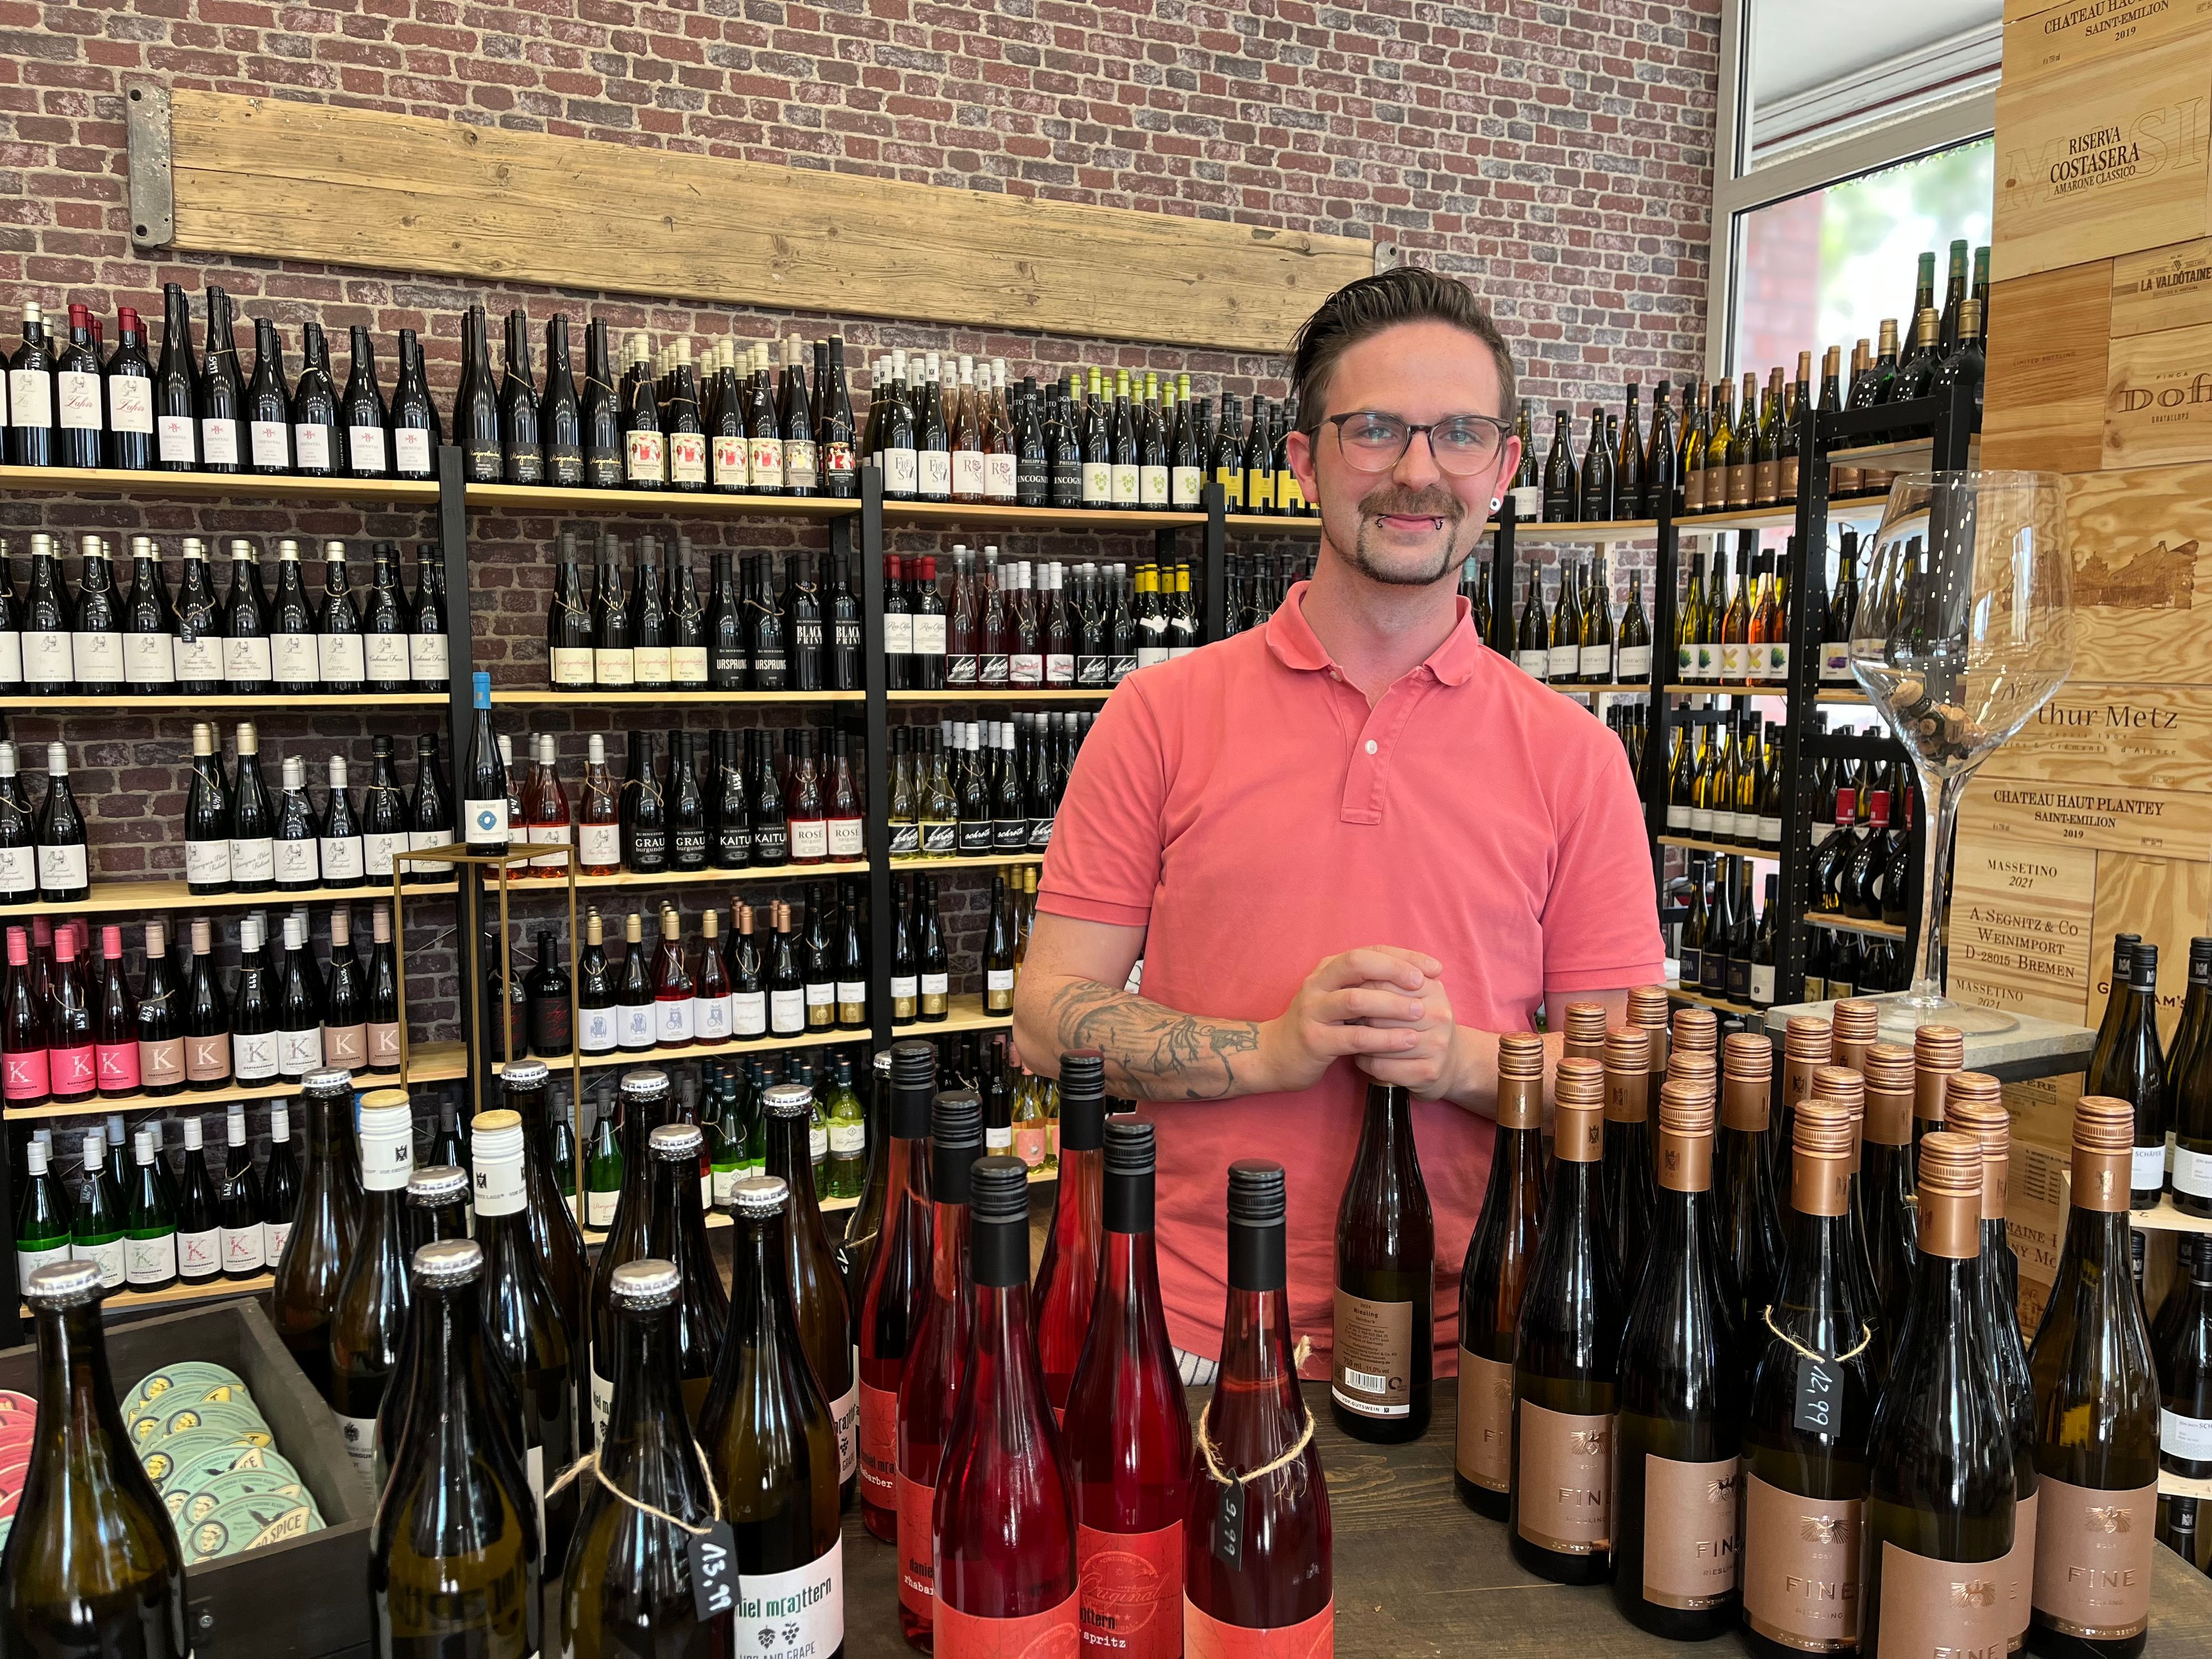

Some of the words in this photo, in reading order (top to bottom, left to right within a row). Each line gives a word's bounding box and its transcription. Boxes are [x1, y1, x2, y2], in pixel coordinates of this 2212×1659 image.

[2044, 1, 2104, 34] CHATEAU
[2085, 0, 2169, 37] SAINT-EMILION
[2115, 26, 2136, 41] 2019
[2069, 126, 2121, 155] RISERVA
[1999, 96, 2203, 214] MASI
[2050, 142, 2140, 184] COSTASERA
[2053, 175, 2095, 195] AMARONE
[2095, 165, 2136, 187] CLASSICO
[2141, 278, 2152, 292] LA
[2013, 358, 2039, 366] LIMITED
[2042, 352, 2076, 362] BOTTLING
[2157, 372, 2188, 380] FINCA
[65, 395, 93, 409] Zahir
[115, 398, 145, 413] Zahir
[797, 625, 822, 637] BLACK
[836, 625, 860, 638] BLACK
[717, 659, 747, 670] URSPRUNG
[755, 659, 786, 670] URSPRUNG
[2106, 703, 2178, 729] Metz
[1994, 790, 2054, 807] CHATEAU
[2057, 794, 2095, 810] HAUT
[2096, 798, 2164, 816] PLANTEY
[2034, 811, 2116, 828] SAINT-EMILION
[676, 836, 705, 846] GRAU
[798, 830, 823, 839] ROSÉ
[836, 827, 859, 837] ROSÉ
[965, 827, 990, 840] schroth
[997, 825, 1025, 838] schroth
[2063, 829, 2084, 839] 2019
[635, 838, 665, 847] GRAU
[1987, 859, 2057, 878] MASSETINO
[2009, 875, 2033, 889] 2021
[2044, 922, 2053, 933] &
[1978, 927, 2065, 956] WEINIMPORT
[1966, 946, 2010, 966] D-28015
[2018, 955, 2075, 978] BREMEN
[1956, 979, 2023, 1001] MASSETINO
[1977, 997, 2000, 1010] 2021
[289, 1038, 312, 1059] K
[334, 1034, 356, 1055] K
[379, 1030, 400, 1051] K
[152, 1047, 175, 1070] K
[196, 1042, 219, 1065] K
[247, 1041, 270, 1063] K
[8, 1061, 32, 1083] K
[71, 1053, 93, 1077] K
[100, 1052, 124, 1074] K
[186, 1239, 207, 1261] K
[229, 1235, 252, 1256] K
[1354, 1307, 1378, 1318] Riesling
[1344, 1357, 1353, 1366] 750
[1805, 1365, 1833, 1427] 12,99
[1559, 1487, 1601, 1507] FIN
[270, 1514, 301, 1543] SPICE
[1224, 1498, 1237, 1556] 9,99
[1696, 1536, 1733, 1559] FIN
[702, 1542, 732, 1611] 13,99
[1703, 1565, 1734, 1576] RIESLIN
[2068, 1566, 2136, 1589] FINE
[1786, 1575, 1855, 1601] FINE
[787, 1641, 816, 1659] GRAPE
[1083, 1631, 1126, 1648] spritz
